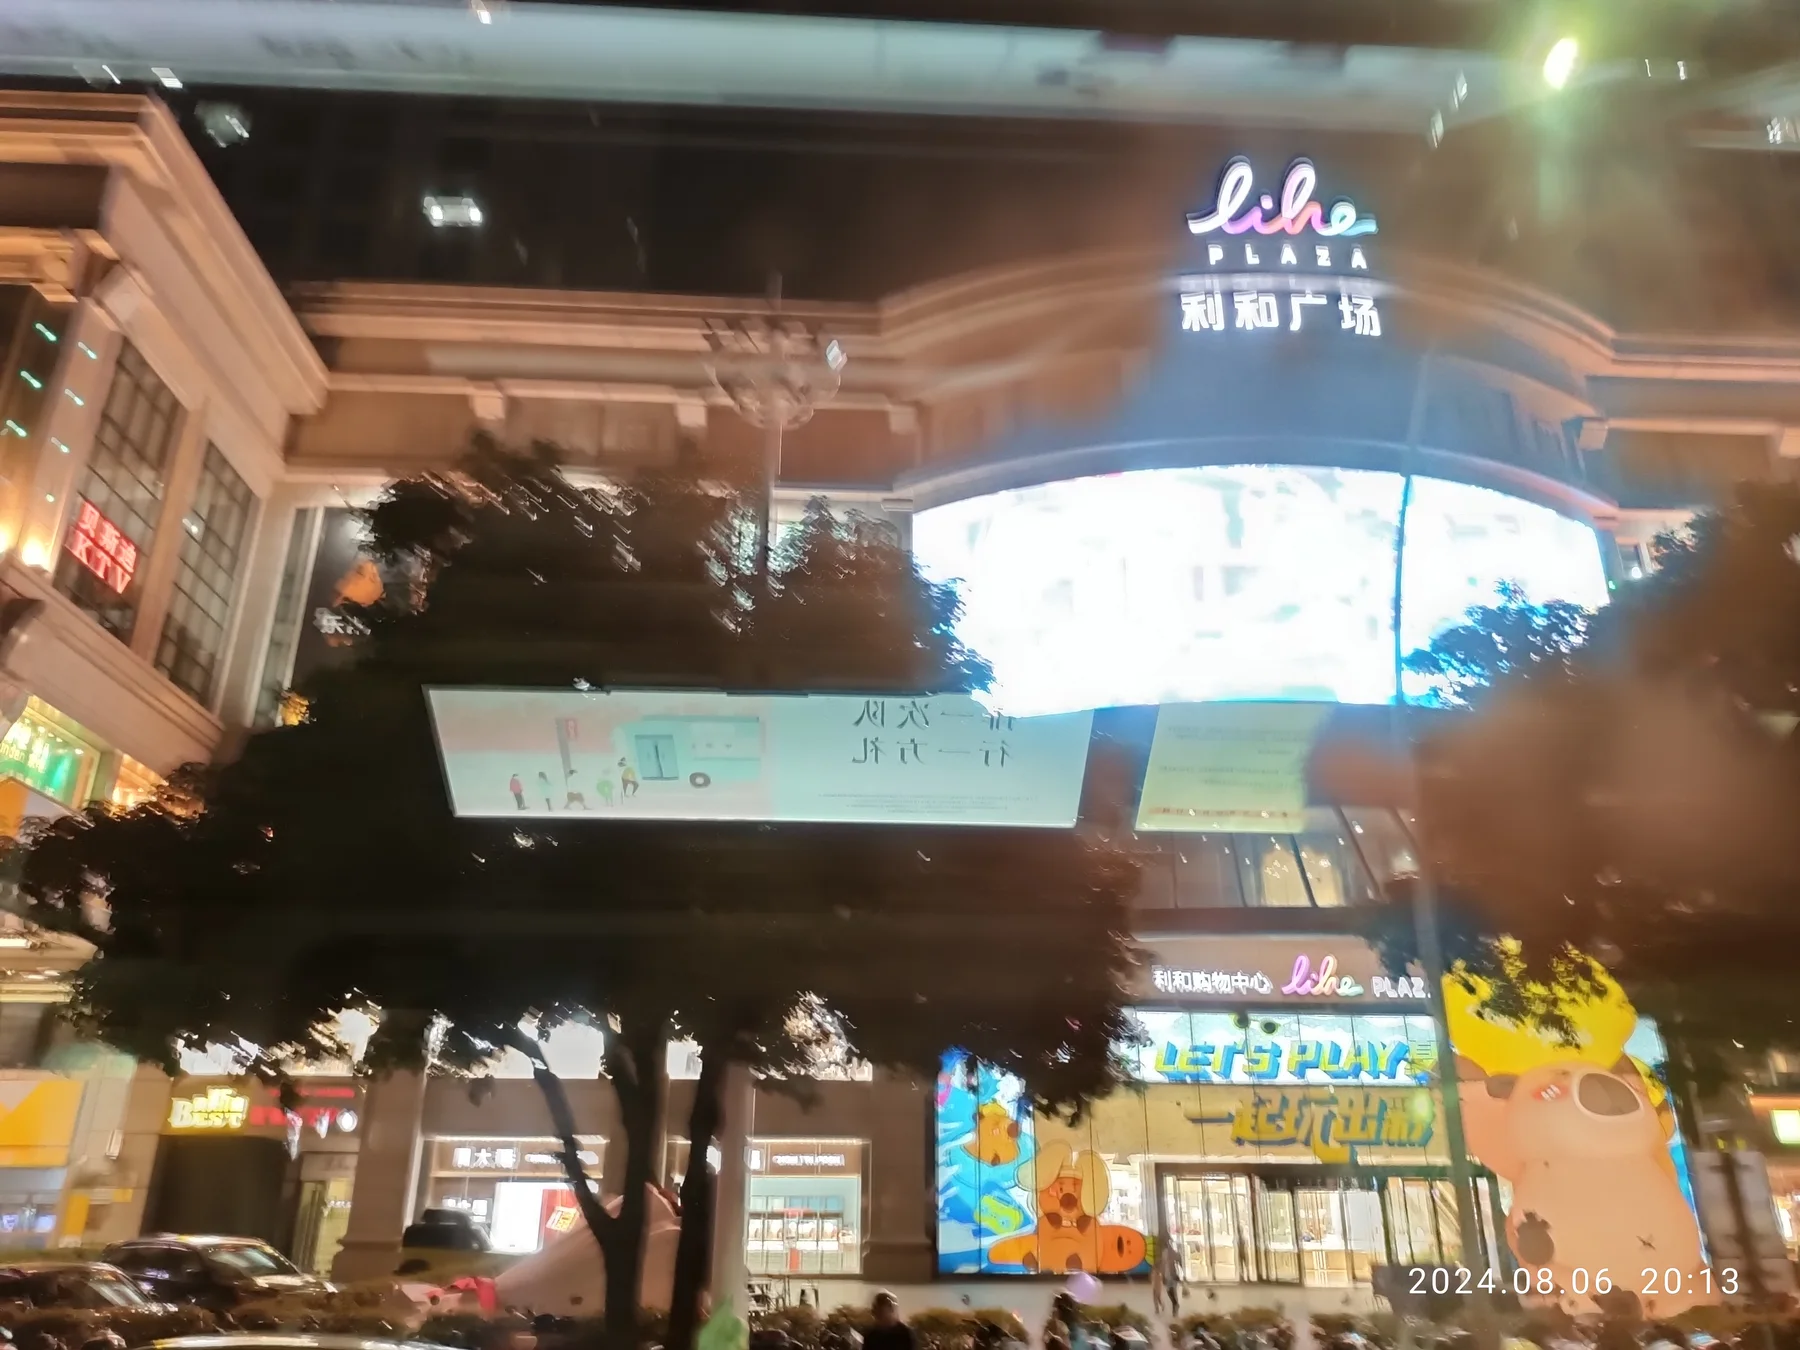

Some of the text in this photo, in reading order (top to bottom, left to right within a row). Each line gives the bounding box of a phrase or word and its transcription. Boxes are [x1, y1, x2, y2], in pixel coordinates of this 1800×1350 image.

[1187, 158, 1378, 236] lihe
[1208, 243, 1367, 269] PLAZA
[1180, 290, 1382, 337] 利和广场
[66, 526, 132, 594] KTV
[1152, 968, 1272, 994] 利和购物中心
[1281, 954, 1431, 998] lihe PLAZ
[1287, 1040, 1409, 1079] PLAY
